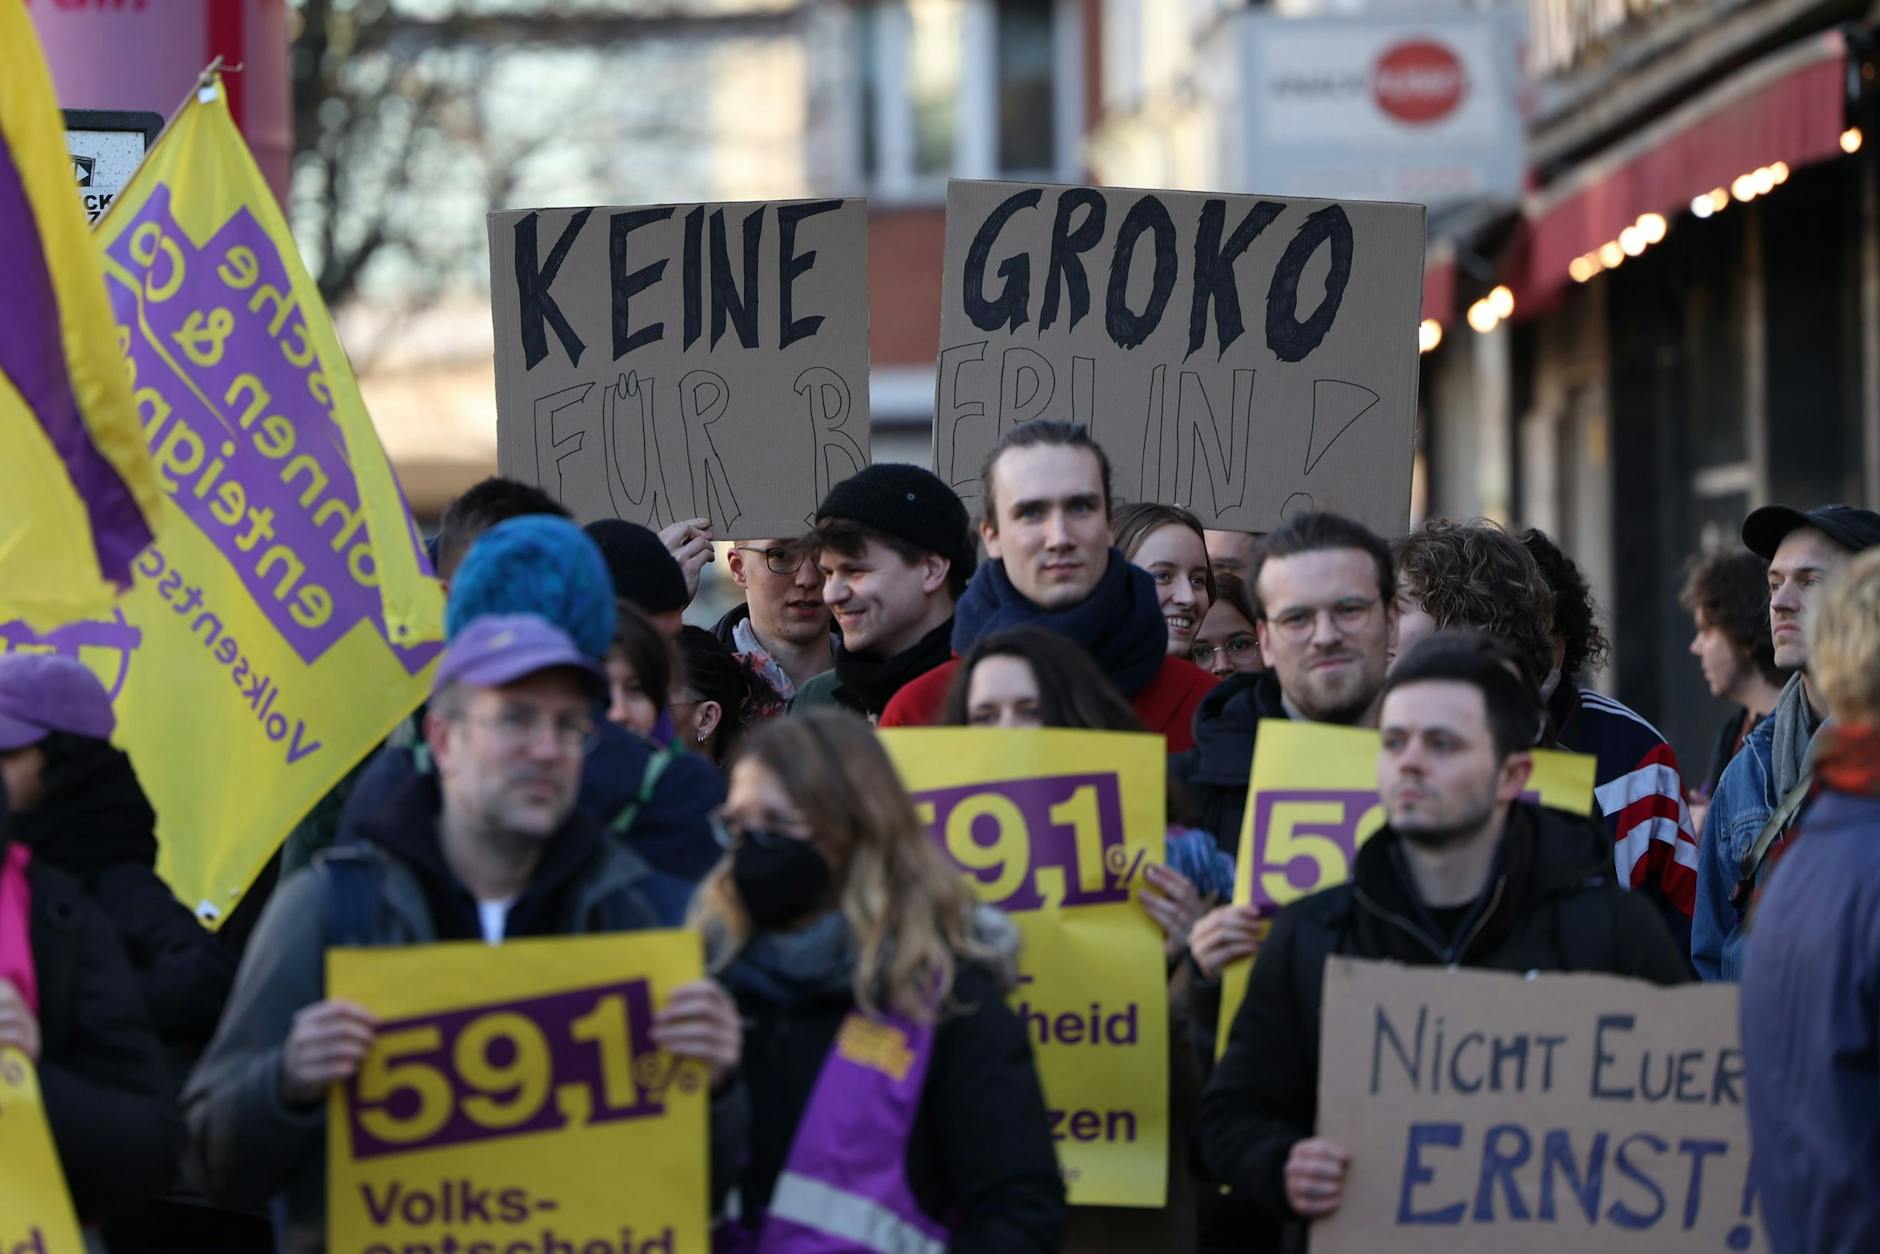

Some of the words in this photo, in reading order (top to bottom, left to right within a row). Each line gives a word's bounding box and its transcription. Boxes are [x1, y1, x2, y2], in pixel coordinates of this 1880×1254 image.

[514, 199, 844, 371] KEINE
[962, 187, 1354, 365] GROKO
[533, 369, 742, 534] FÜR
[1018, 1002, 1138, 1045] heid
[1047, 1108, 1137, 1143] zen
[1395, 1121, 1757, 1253] ERNST!
[359, 1177, 559, 1228] Volks-
